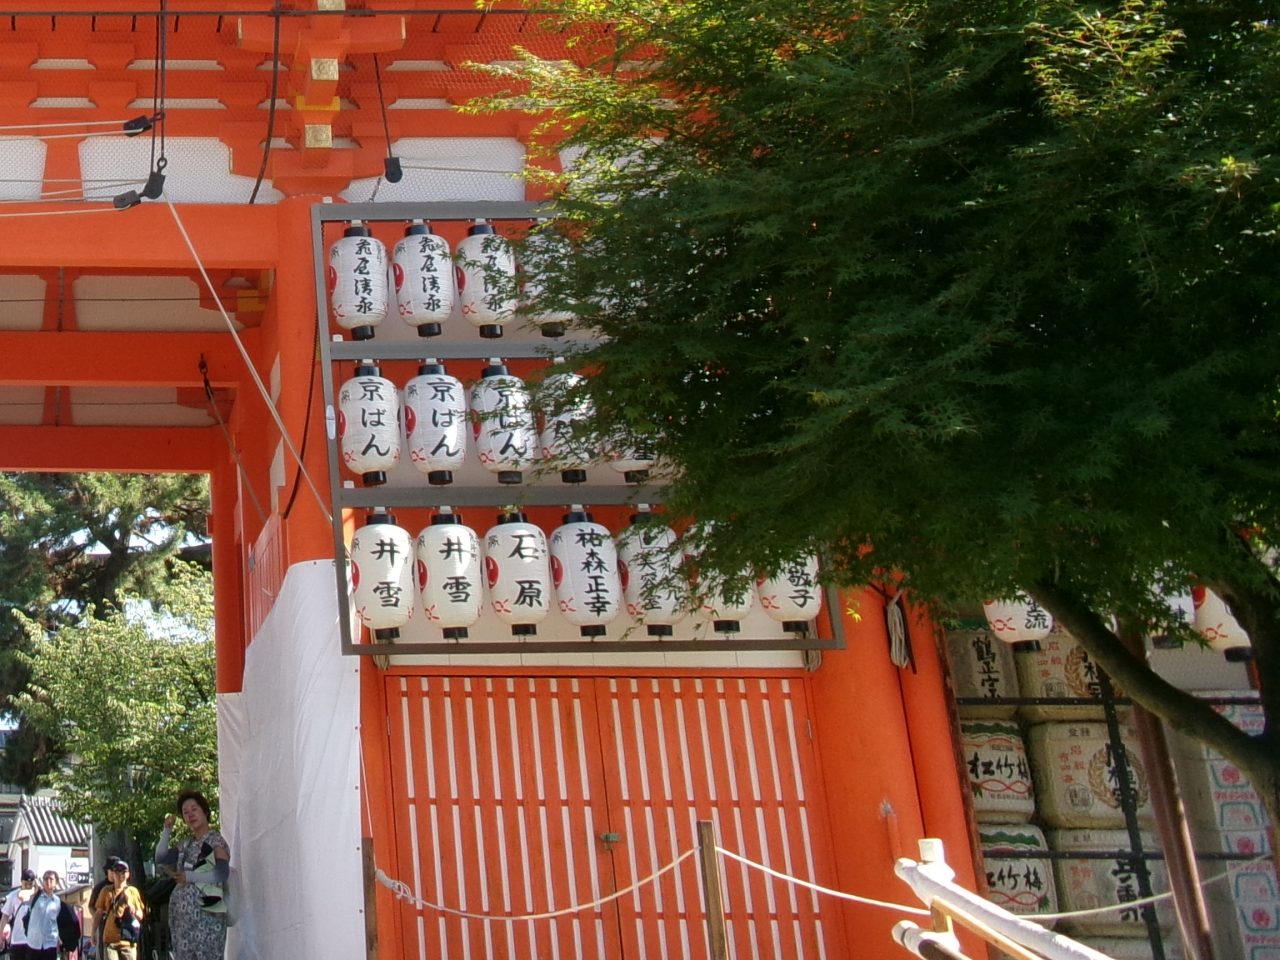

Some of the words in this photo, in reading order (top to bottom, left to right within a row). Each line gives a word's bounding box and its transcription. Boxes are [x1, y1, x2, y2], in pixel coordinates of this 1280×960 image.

[358, 378, 390, 457] 京ばん
[429, 378, 460, 457] 京ばん
[371, 538, 402, 608] 井雪
[439, 537, 472, 604] 井雪
[508, 534, 543, 608] 石原
[575, 528, 611, 617] 祐森正幸
